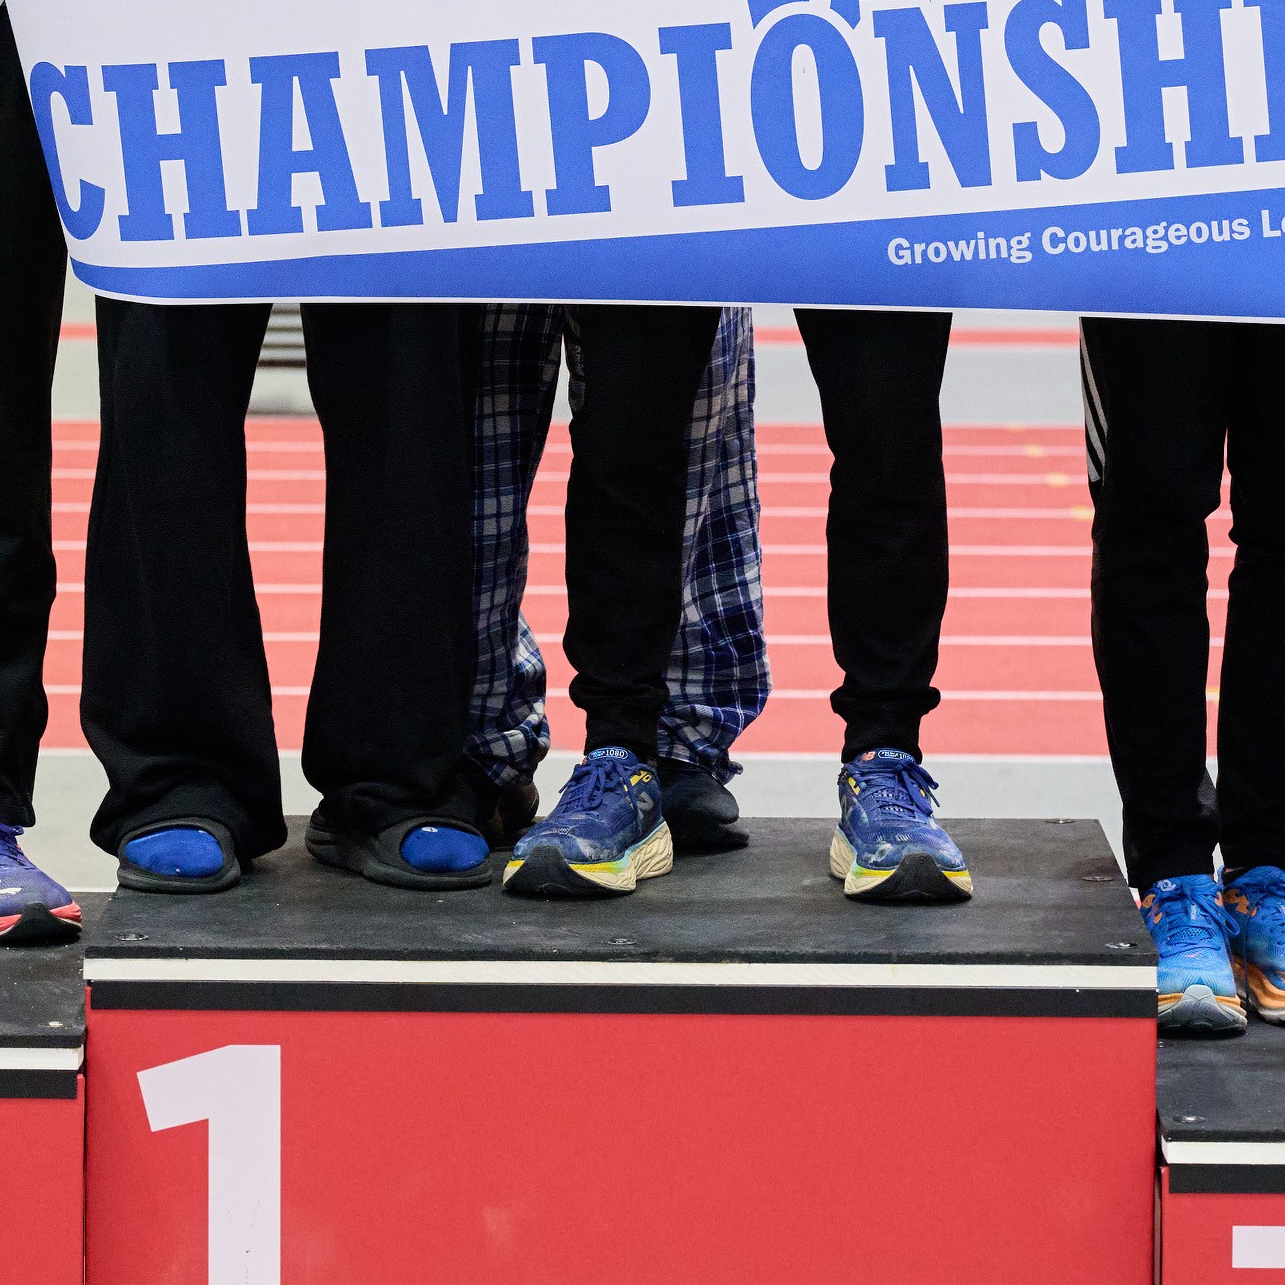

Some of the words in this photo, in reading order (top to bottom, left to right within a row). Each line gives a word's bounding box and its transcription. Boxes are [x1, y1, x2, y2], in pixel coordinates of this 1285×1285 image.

[887, 229, 1034, 266] Growing
[1041, 212, 1251, 255] Courageous
[136, 1044, 281, 1285] 1
